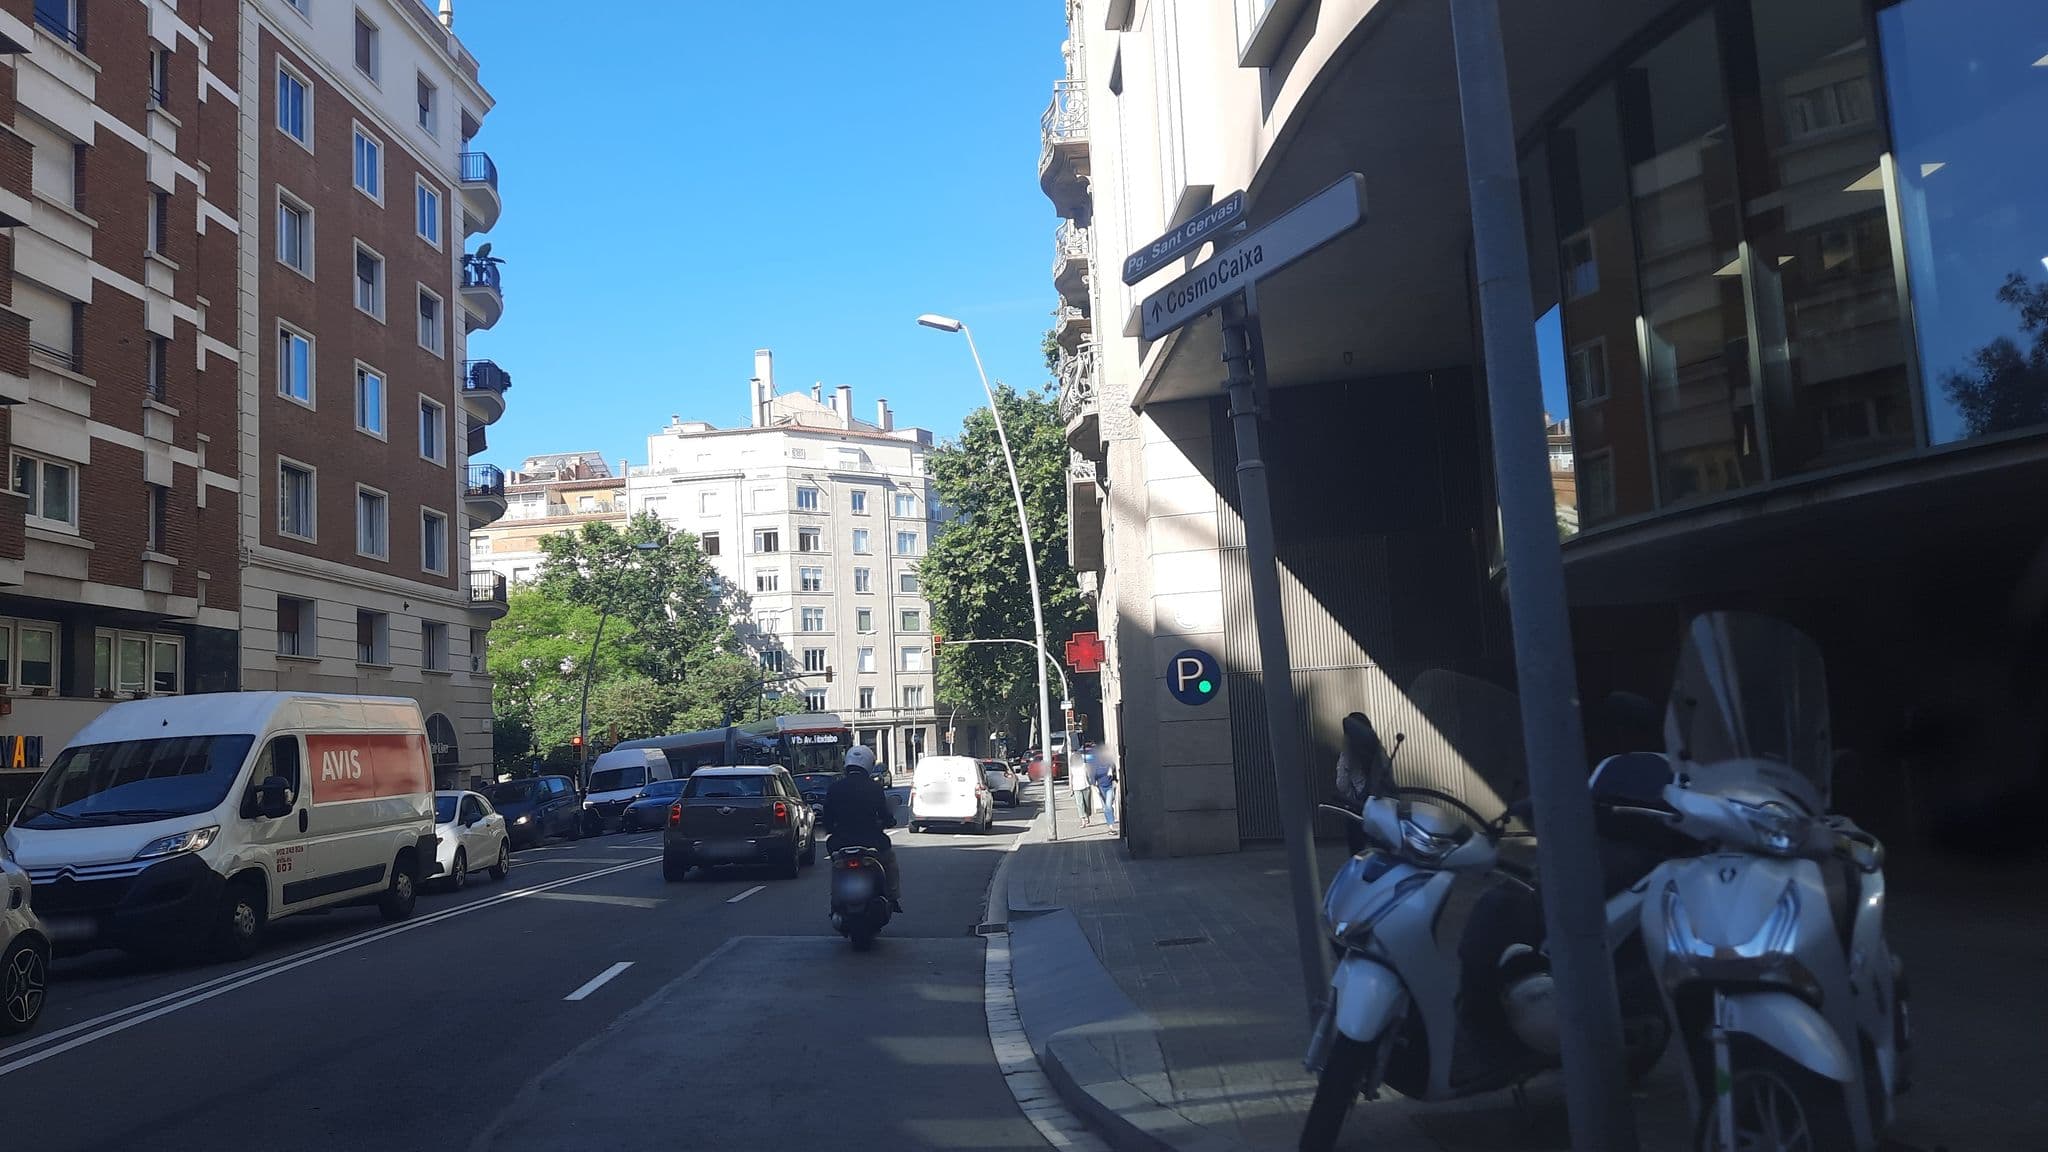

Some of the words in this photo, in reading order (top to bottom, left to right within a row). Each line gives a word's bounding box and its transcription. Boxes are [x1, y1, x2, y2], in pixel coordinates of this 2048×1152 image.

[1127, 256, 1148, 274] Pg.
[1151, 231, 1182, 259] Sant
[1185, 195, 1239, 238] Gervasi
[1166, 244, 1264, 314] CosmoCaixa
[1177, 658, 1204, 691] P
[321, 749, 362, 781] AVIS
